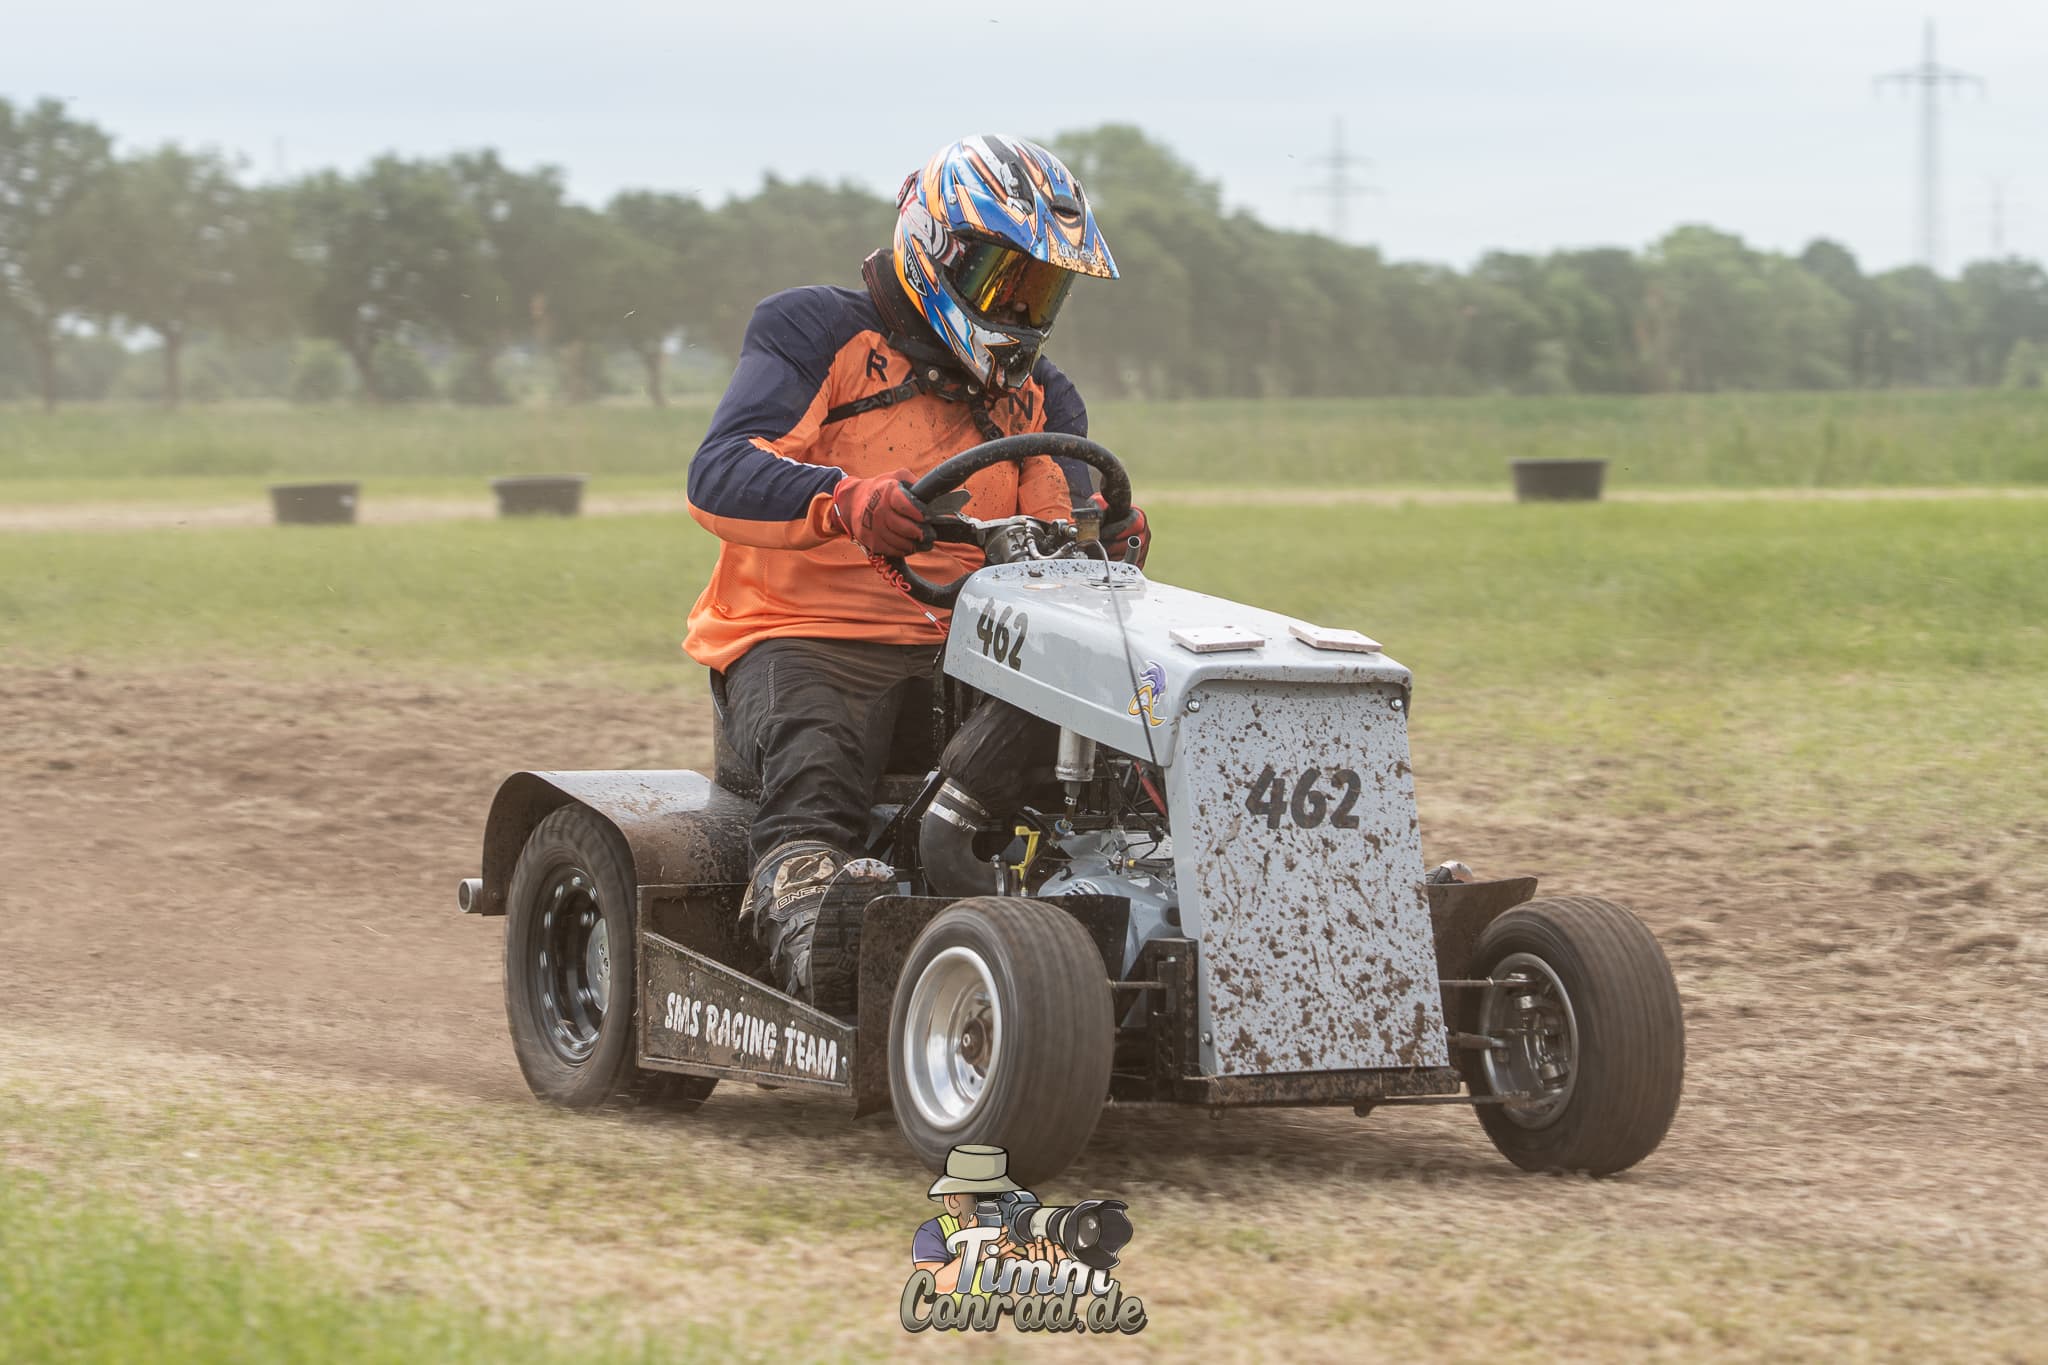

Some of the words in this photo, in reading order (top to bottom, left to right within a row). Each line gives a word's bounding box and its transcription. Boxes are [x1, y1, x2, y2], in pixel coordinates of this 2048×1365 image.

[906, 254, 922, 287] uvex
[1059, 243, 1099, 265] uvex
[976, 597, 1029, 671] 462
[1245, 765, 1362, 829] 462
[664, 991, 702, 1038] SMS
[705, 1003, 778, 1062] RACING
[784, 1026, 838, 1081] TEAM
